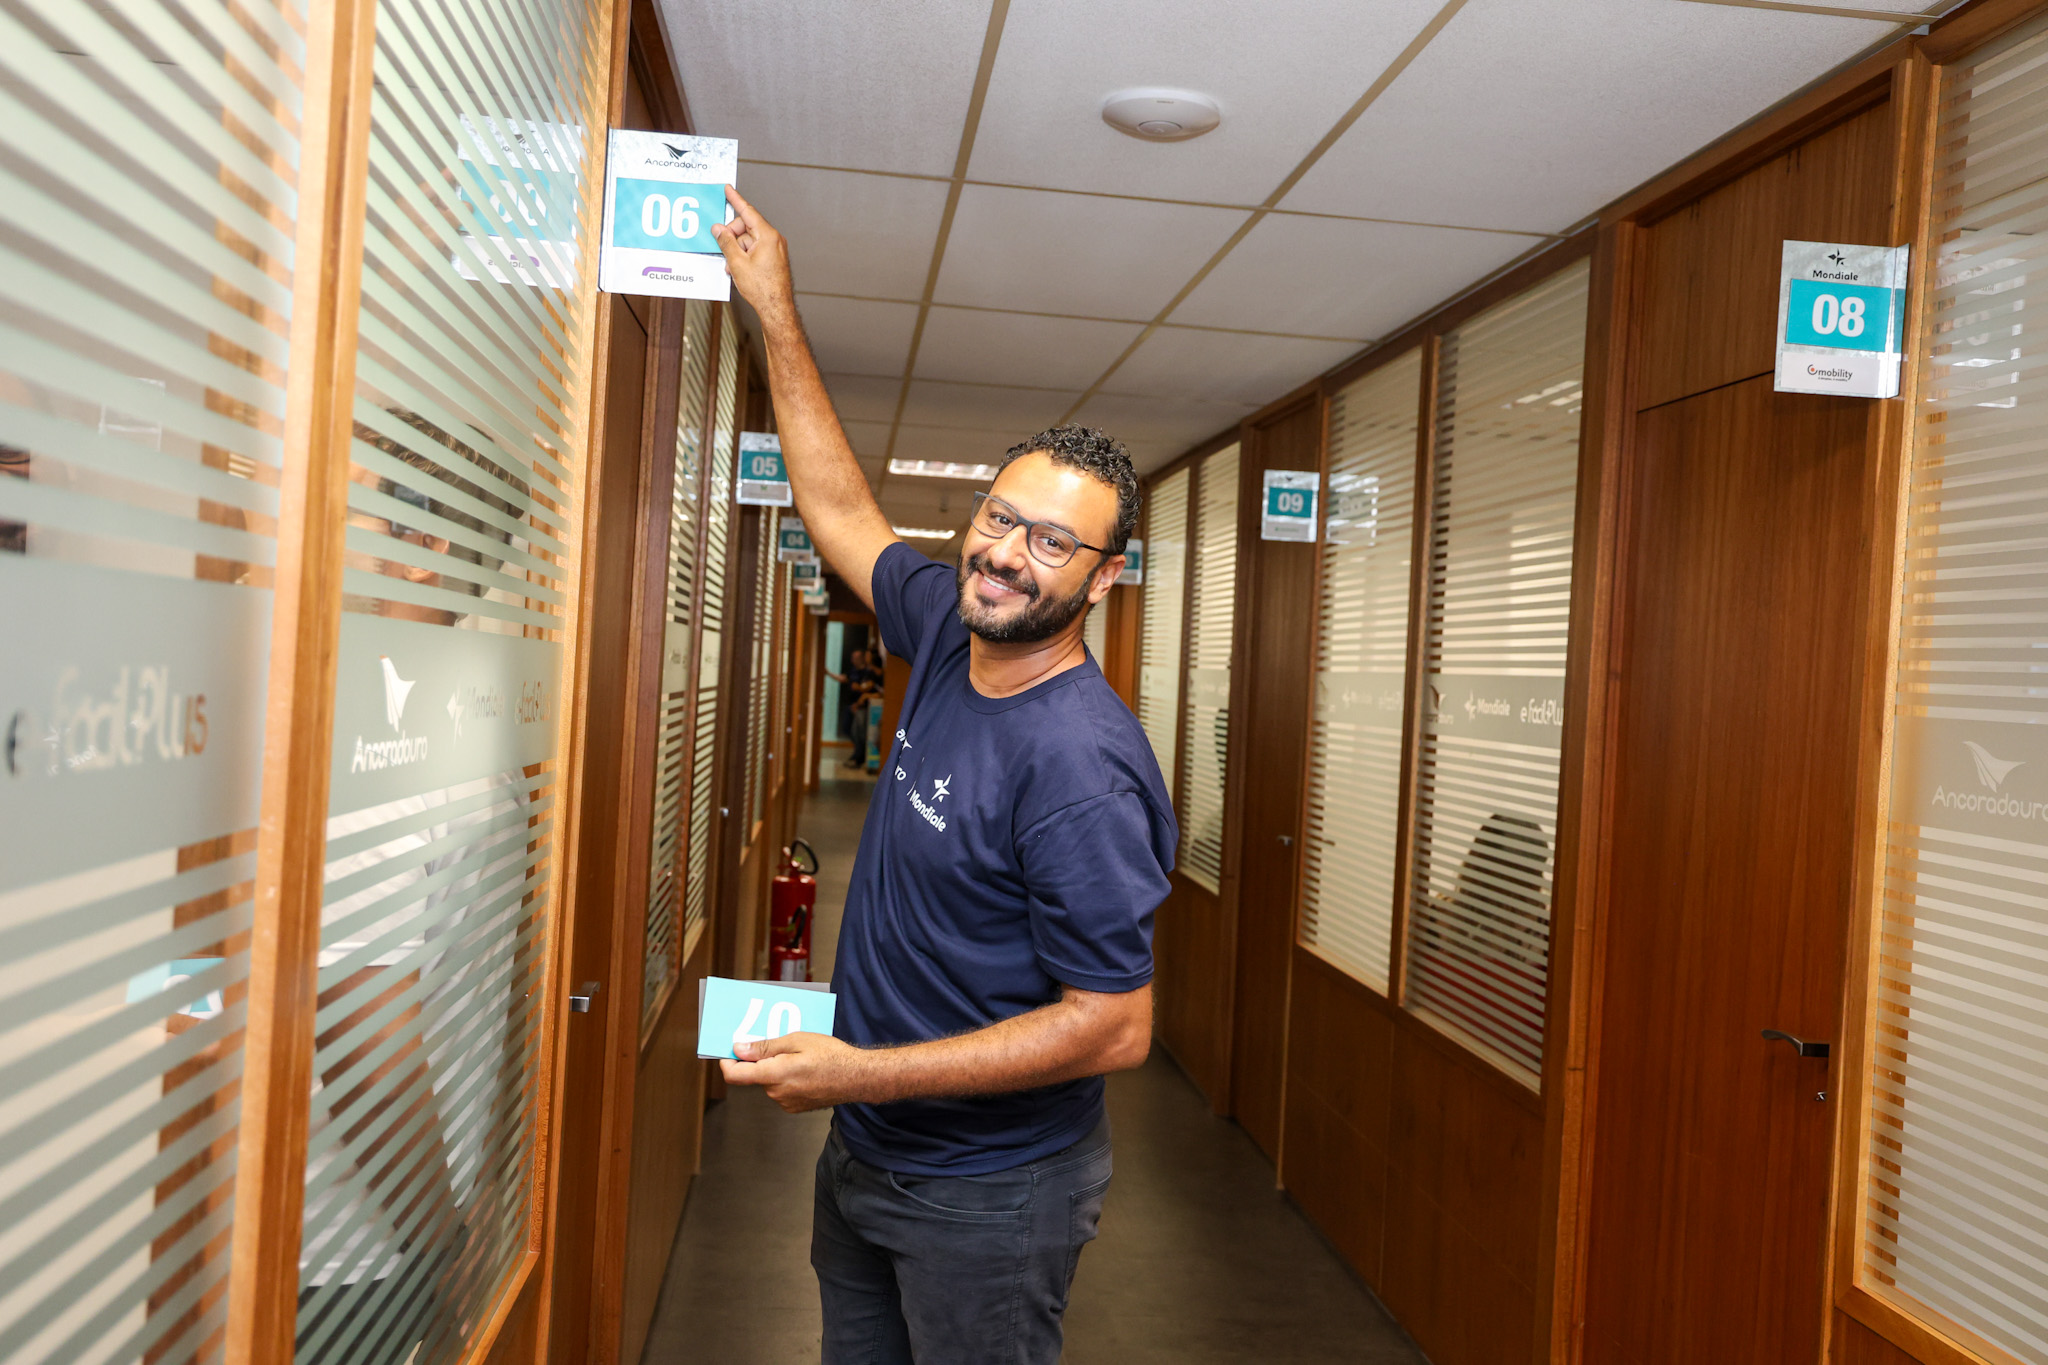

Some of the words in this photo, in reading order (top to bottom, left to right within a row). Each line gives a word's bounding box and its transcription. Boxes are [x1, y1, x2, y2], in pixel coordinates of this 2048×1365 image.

[644, 157, 708, 171] Ancoradouro
[641, 193, 700, 239] 06
[648, 272, 694, 283] CLICKBUS
[1812, 269, 1859, 281] Mondiale
[1811, 293, 1866, 338] 08
[752, 455, 778, 477] 05
[1277, 492, 1304, 513] 09
[1477, 697, 1511, 716] Mondiale
[351, 729, 428, 774] Ancoradouro
[909, 789, 947, 833] Mondiale
